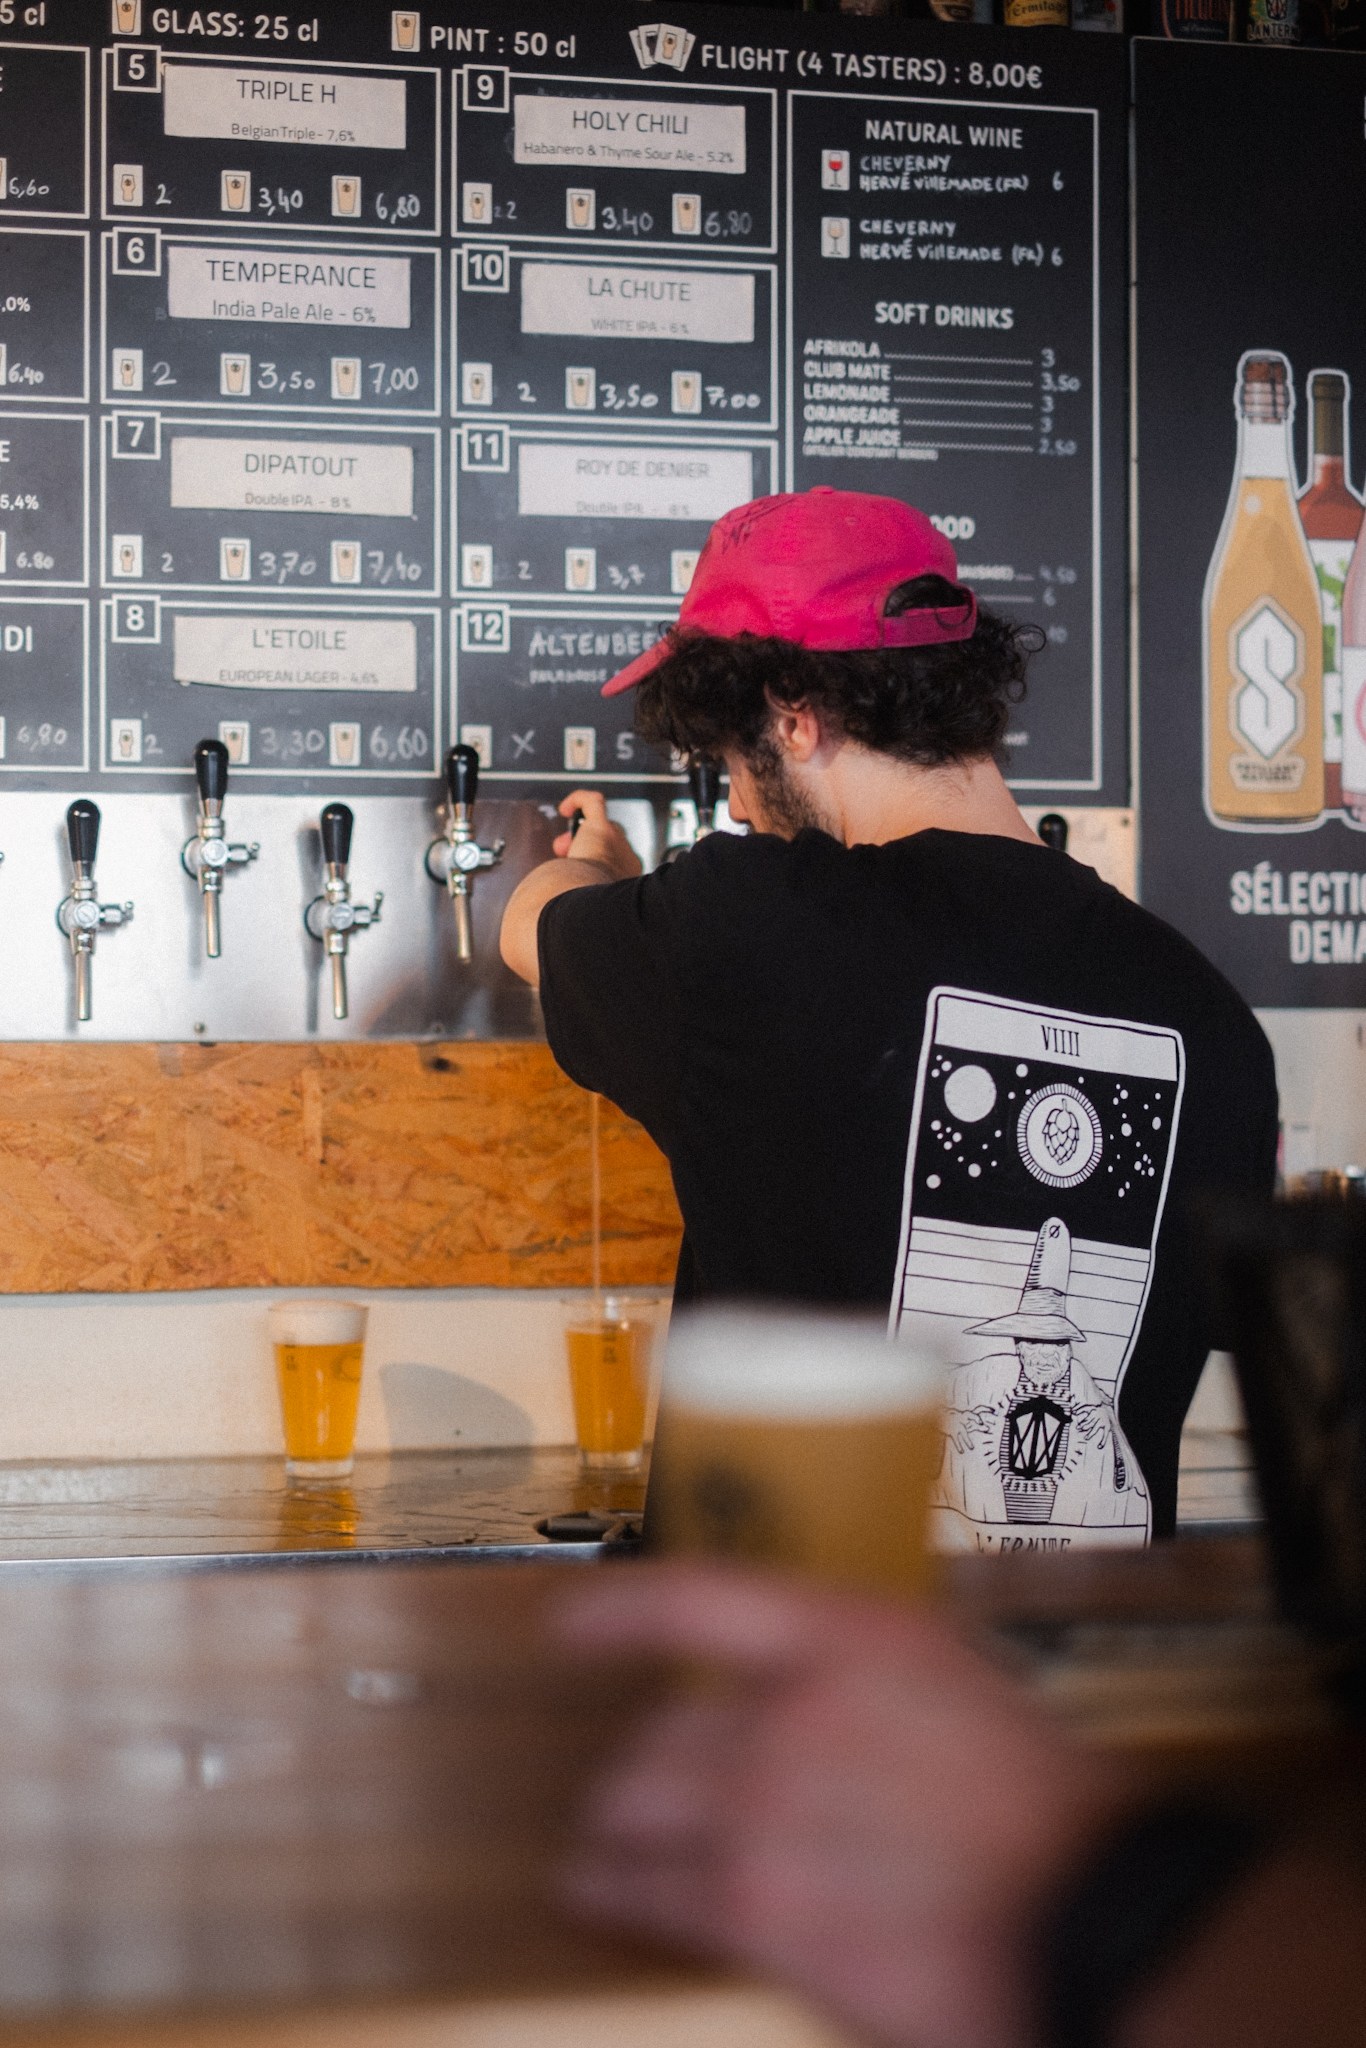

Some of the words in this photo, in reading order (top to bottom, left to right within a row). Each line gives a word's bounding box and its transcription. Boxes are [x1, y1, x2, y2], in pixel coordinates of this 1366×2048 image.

[24, 1, 45, 26] cl
[152, 8, 245, 38] GLASS:
[254, 15, 289, 41] 25
[298, 18, 319, 42] cl
[429, 26, 489, 53] PINT
[514, 32, 548, 57] 50
[556, 35, 576, 58] cl
[128, 54, 145, 80] 5
[701, 45, 789, 71] FLIGHT
[797, 51, 823, 77] (4
[832, 53, 947, 86] TASTERS)
[968, 62, 1042, 89] 8,00€
[236, 78, 313, 103] TRIPLE
[321, 84, 337, 103] H
[477, 75, 494, 100] 9
[573, 110, 630, 131] HOLY
[636, 113, 688, 135] CHILI
[866, 119, 962, 145] NATURAL
[968, 126, 1023, 149] WINE
[523, 142, 584, 157] Habanero
[587, 144, 597, 156] &
[601, 145, 642, 161] Thyme
[644, 147, 673, 161] Sour
[675, 148, 695, 162] Ale
[860, 155, 951, 172] CHEVERNY
[8, 177, 50, 198] 6,60
[1052, 171, 1064, 191] 6
[155, 184, 171, 205] 2
[258, 188, 303, 216] 3,40
[374, 193, 420, 225] 6,80
[507, 201, 517, 219] 2
[860, 220, 956, 237] CHEVERNY
[126, 237, 145, 264] 6
[1052, 247, 1063, 266] 6
[206, 259, 376, 289] TEMPERANCE
[469, 254, 502, 281] 10
[588, 278, 613, 298] LA
[620, 279, 691, 302] CHUTE
[212, 299, 256, 318] India
[261, 301, 300, 320] Pale
[304, 303, 333, 321] Ale
[352, 306, 376, 323] 6%
[875, 301, 930, 325] SOFT
[935, 305, 1014, 329] DRINKS
[591, 318, 634, 332] WHITE
[637, 320, 658, 334] IPA
[803, 339, 881, 358] AFRIKOLA
[1041, 347, 1055, 369] 3
[152, 361, 177, 385] 2
[257, 362, 316, 392] 3,50
[369, 363, 419, 394] 7,00
[803, 360, 846, 379] CLUB
[849, 363, 891, 381] MATE
[517, 382, 536, 403] 2
[599, 383, 660, 410] 3,50
[803, 382, 891, 402] LEMONADE
[803, 404, 900, 424] ORANGEADE
[126, 420, 144, 447] 7
[803, 427, 854, 446] APPLE
[857, 429, 901, 447] JUICE
[469, 434, 499, 460] 11
[244, 453, 358, 477] DIPATOUT
[576, 459, 610, 477] ROY
[617, 461, 639, 477] DE
[646, 462, 710, 479] DENIER
[161, 552, 174, 573] 2
[518, 561, 532, 580] 2
[126, 605, 145, 631] 8
[469, 613, 502, 641] 12
[5, 626, 33, 652] DI
[253, 629, 347, 651] L'ETOILE
[219, 669, 293, 684] EUROPEAN
[296, 670, 338, 685] LAGER
[144, 735, 163, 754] 2
[617, 732, 634, 759] 5
[1041, 1025, 1080, 1056] VIIII
